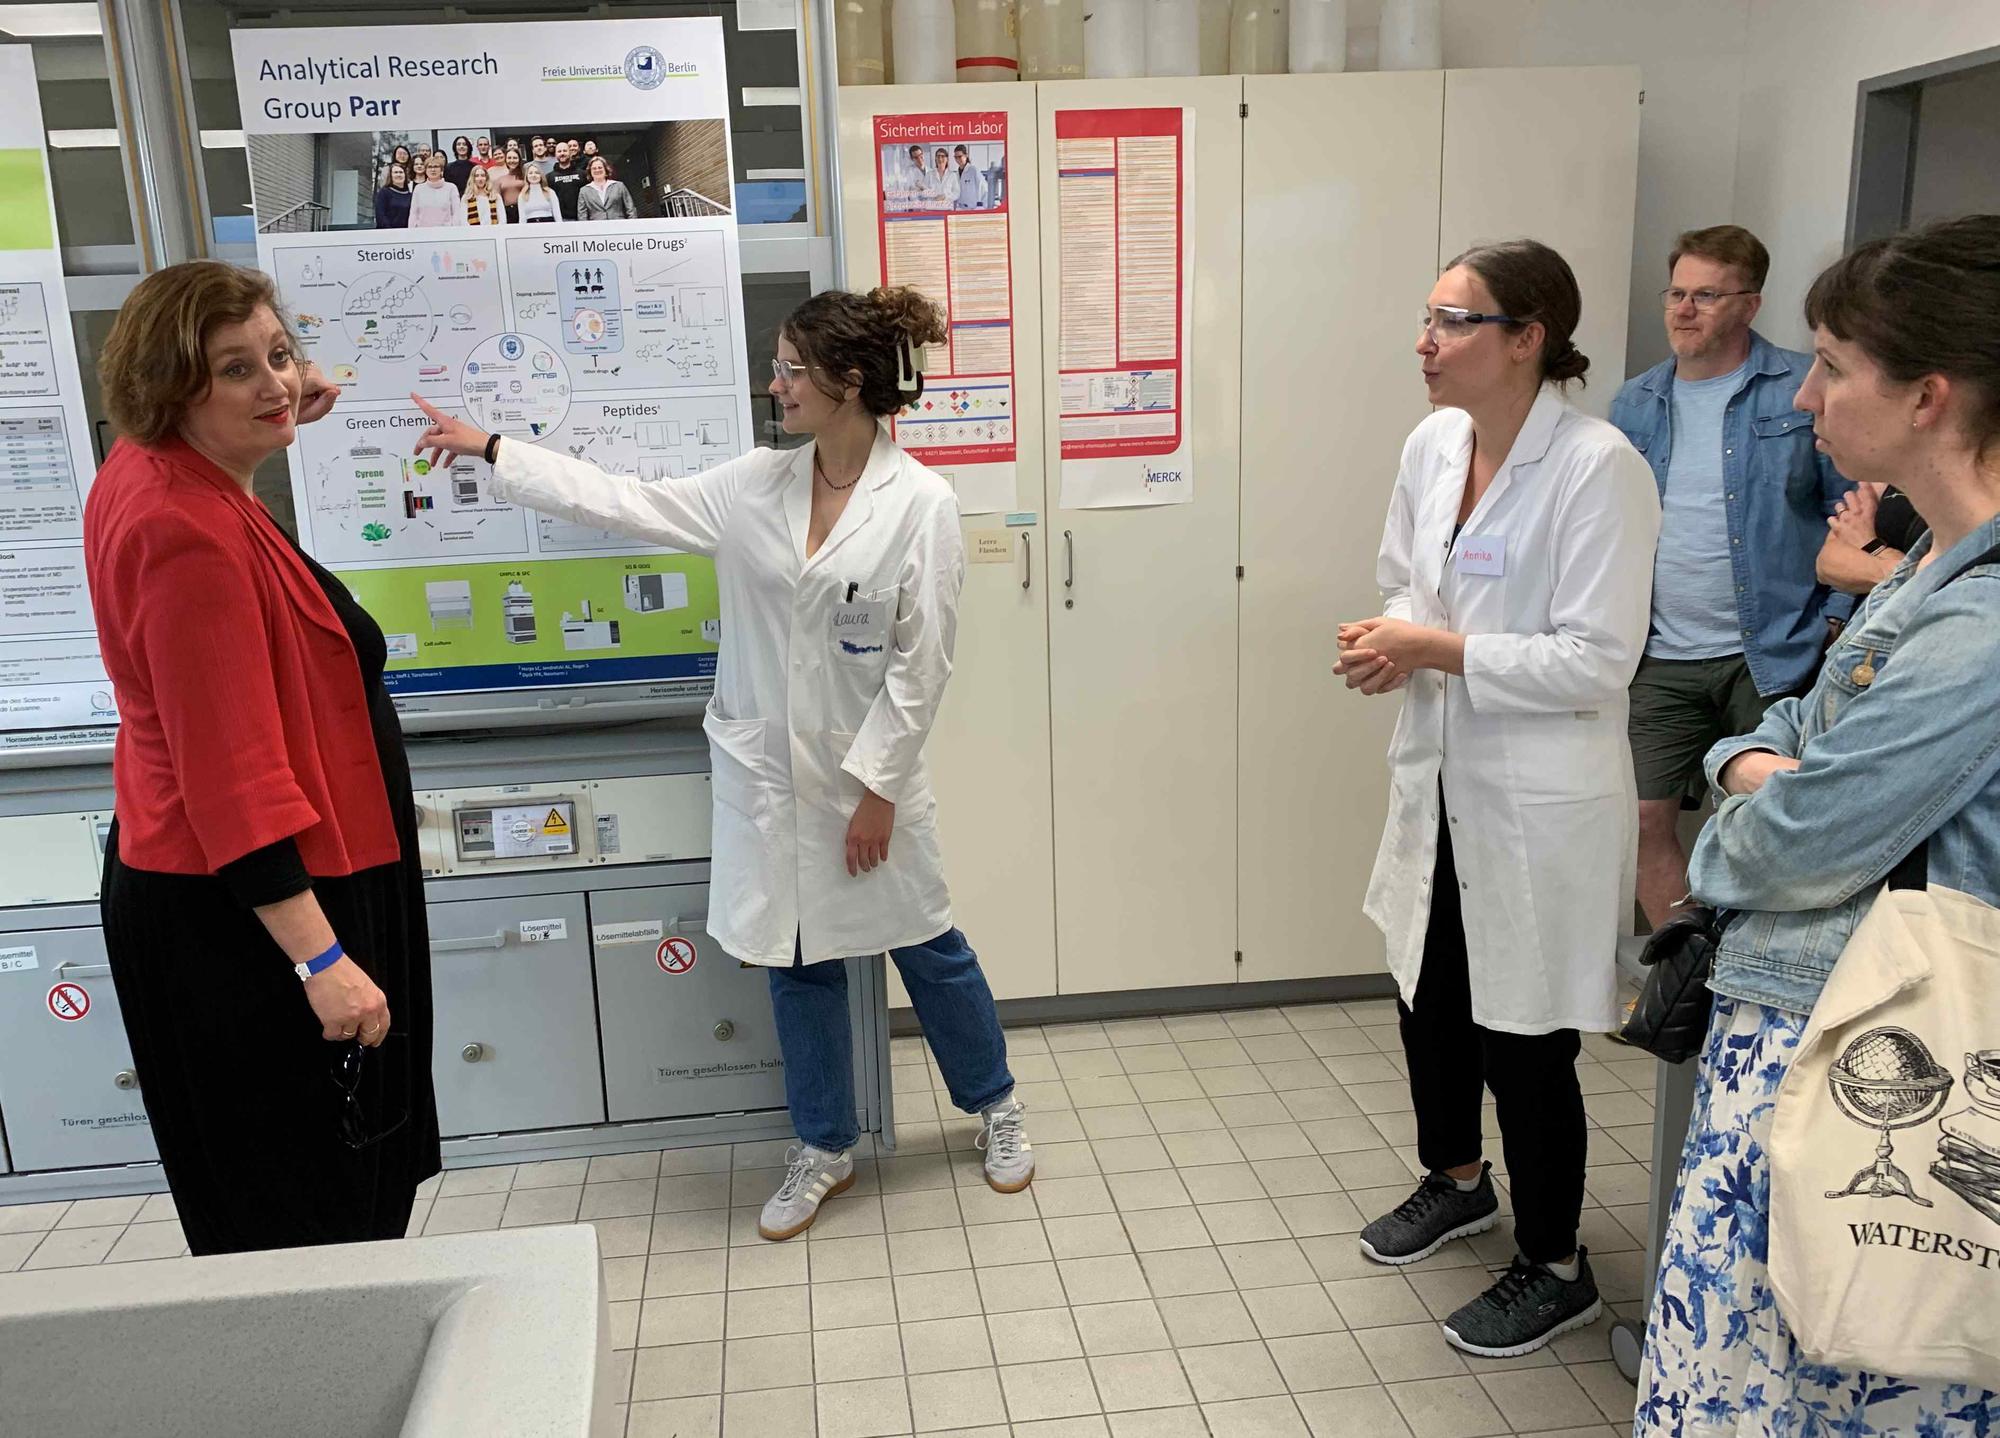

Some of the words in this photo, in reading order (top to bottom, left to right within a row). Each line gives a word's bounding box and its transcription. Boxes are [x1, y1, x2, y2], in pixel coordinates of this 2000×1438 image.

[260, 55, 380, 85] Analytical
[388, 52, 498, 78] Research
[543, 66, 566, 76] Freie
[569, 64, 623, 76] Universität
[668, 62, 697, 73] Berlin
[264, 97, 342, 123] Group
[350, 95, 401, 117] Parr
[879, 122, 946, 138] Sicherheit
[948, 122, 964, 135] im
[968, 120, 1004, 135] Labor
[543, 241, 579, 254] Small
[584, 238, 643, 253] Molecule
[346, 418, 386, 430] Green
[355, 470, 384, 478] Cyrene
[1147, 472, 1181, 482] MERCK
[1463, 549, 1493, 561] Annika
[833, 611, 869, 627] Laura
[522, 922, 562, 933] Lösemittel
[530, 933, 537, 941] D
[596, 928, 659, 942] Lösemittelabfälle
[659, 1068, 689, 1077] Türen
[693, 1063, 757, 1077] geschlossen
[61, 1118, 94, 1127] Türen
[1847, 1221, 2000, 1270] WATERST
